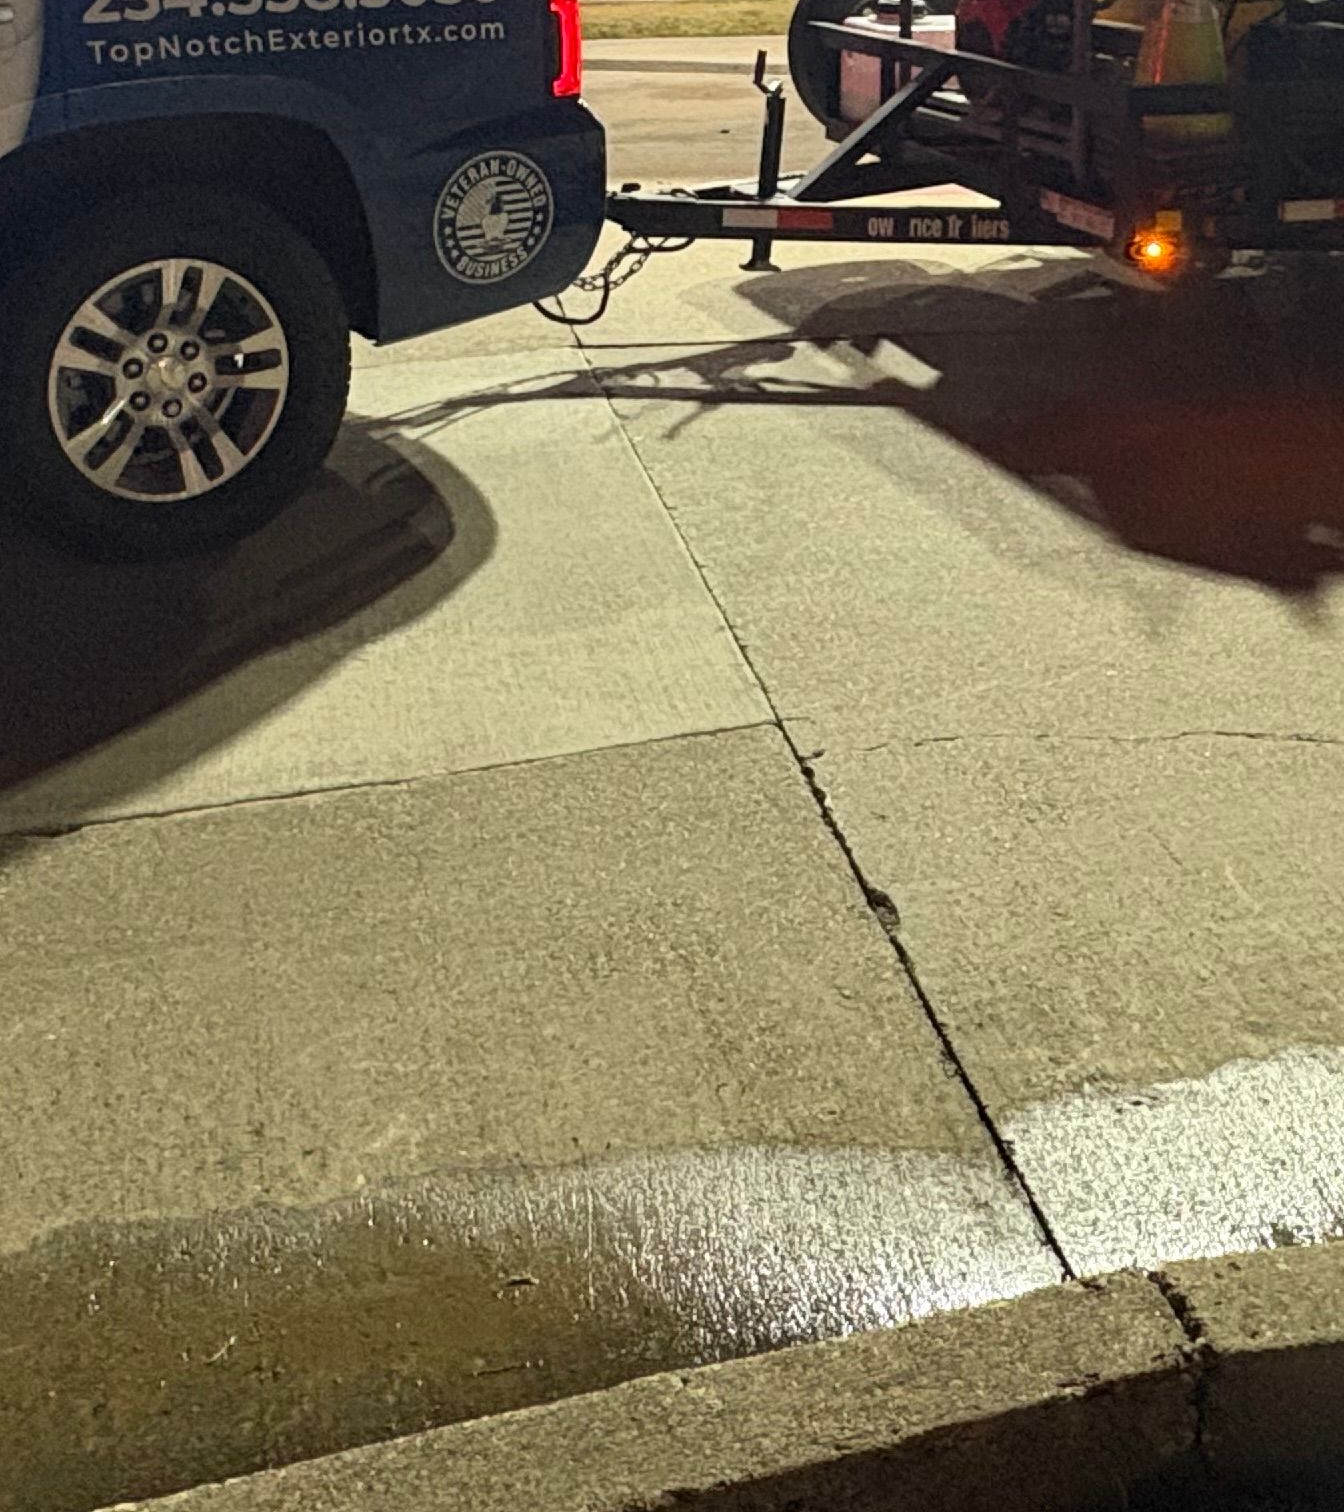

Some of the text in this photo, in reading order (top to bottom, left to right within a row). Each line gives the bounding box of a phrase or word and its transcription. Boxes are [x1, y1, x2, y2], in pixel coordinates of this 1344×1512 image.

[86, 19, 505, 67] TopNotchExteriortx.com
[440, 157, 548, 220] VETERAN-OWNED
[867, 216, 894, 237] ow
[908, 216, 943, 238] rice
[456, 245, 529, 277] BUSINESS
